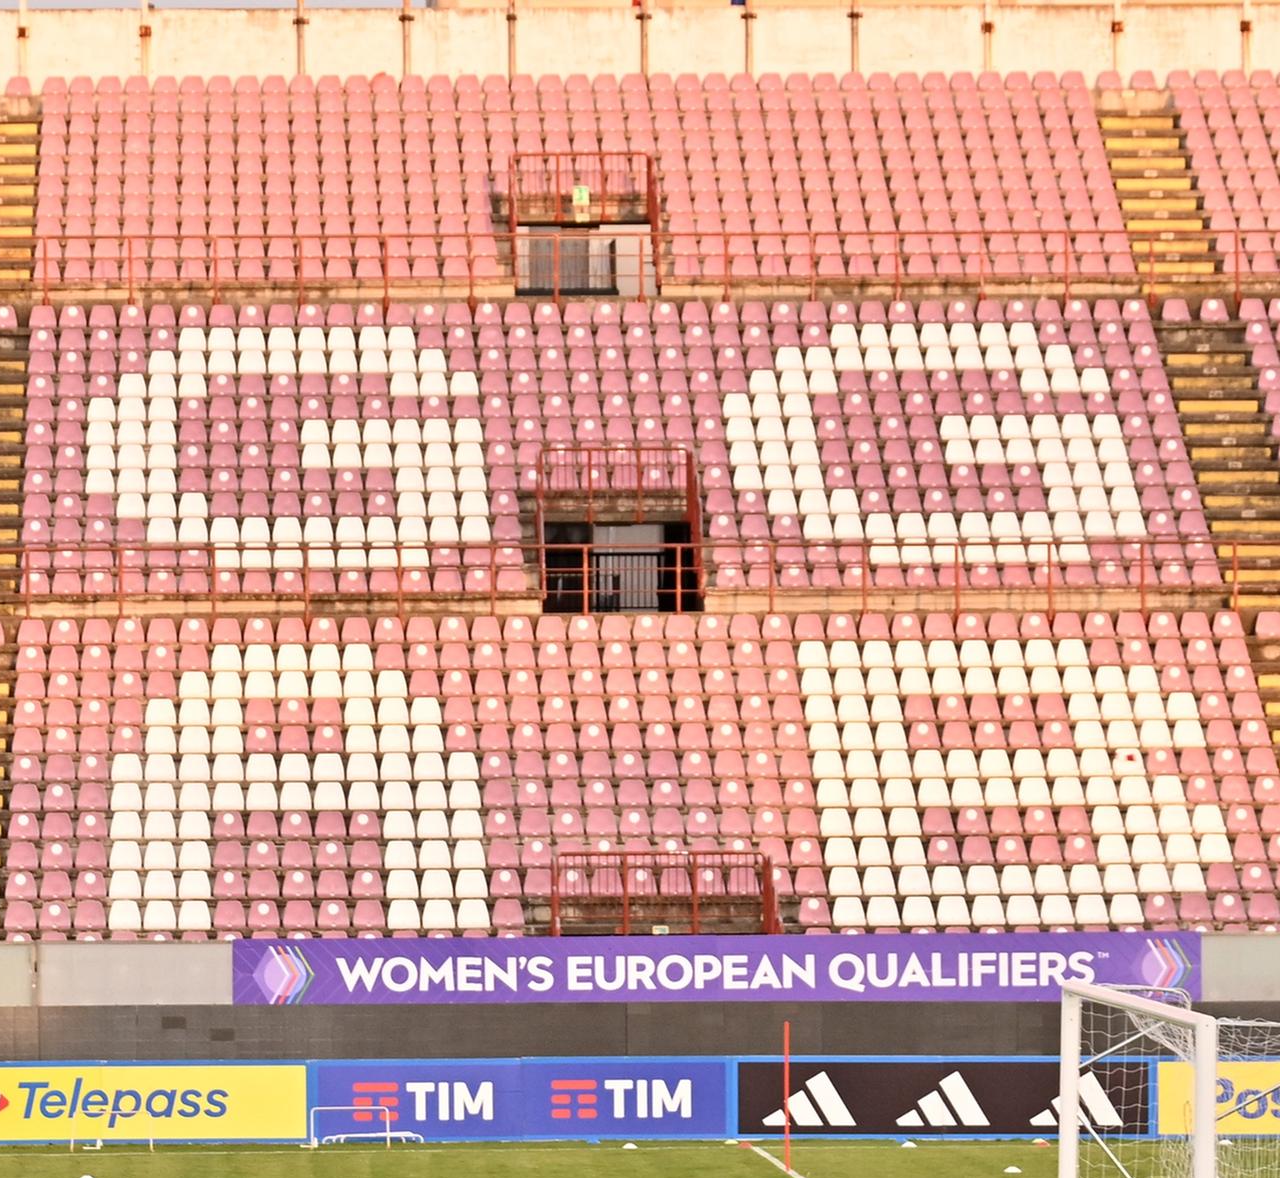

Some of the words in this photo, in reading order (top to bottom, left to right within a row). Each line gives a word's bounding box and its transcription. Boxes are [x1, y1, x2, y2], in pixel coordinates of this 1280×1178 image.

[567, 955, 816, 991] EUROPEAN
[18, 1077, 229, 1128] Telepass
[406, 1081, 494, 1121] TIM
[604, 1079, 693, 1119] TIM
